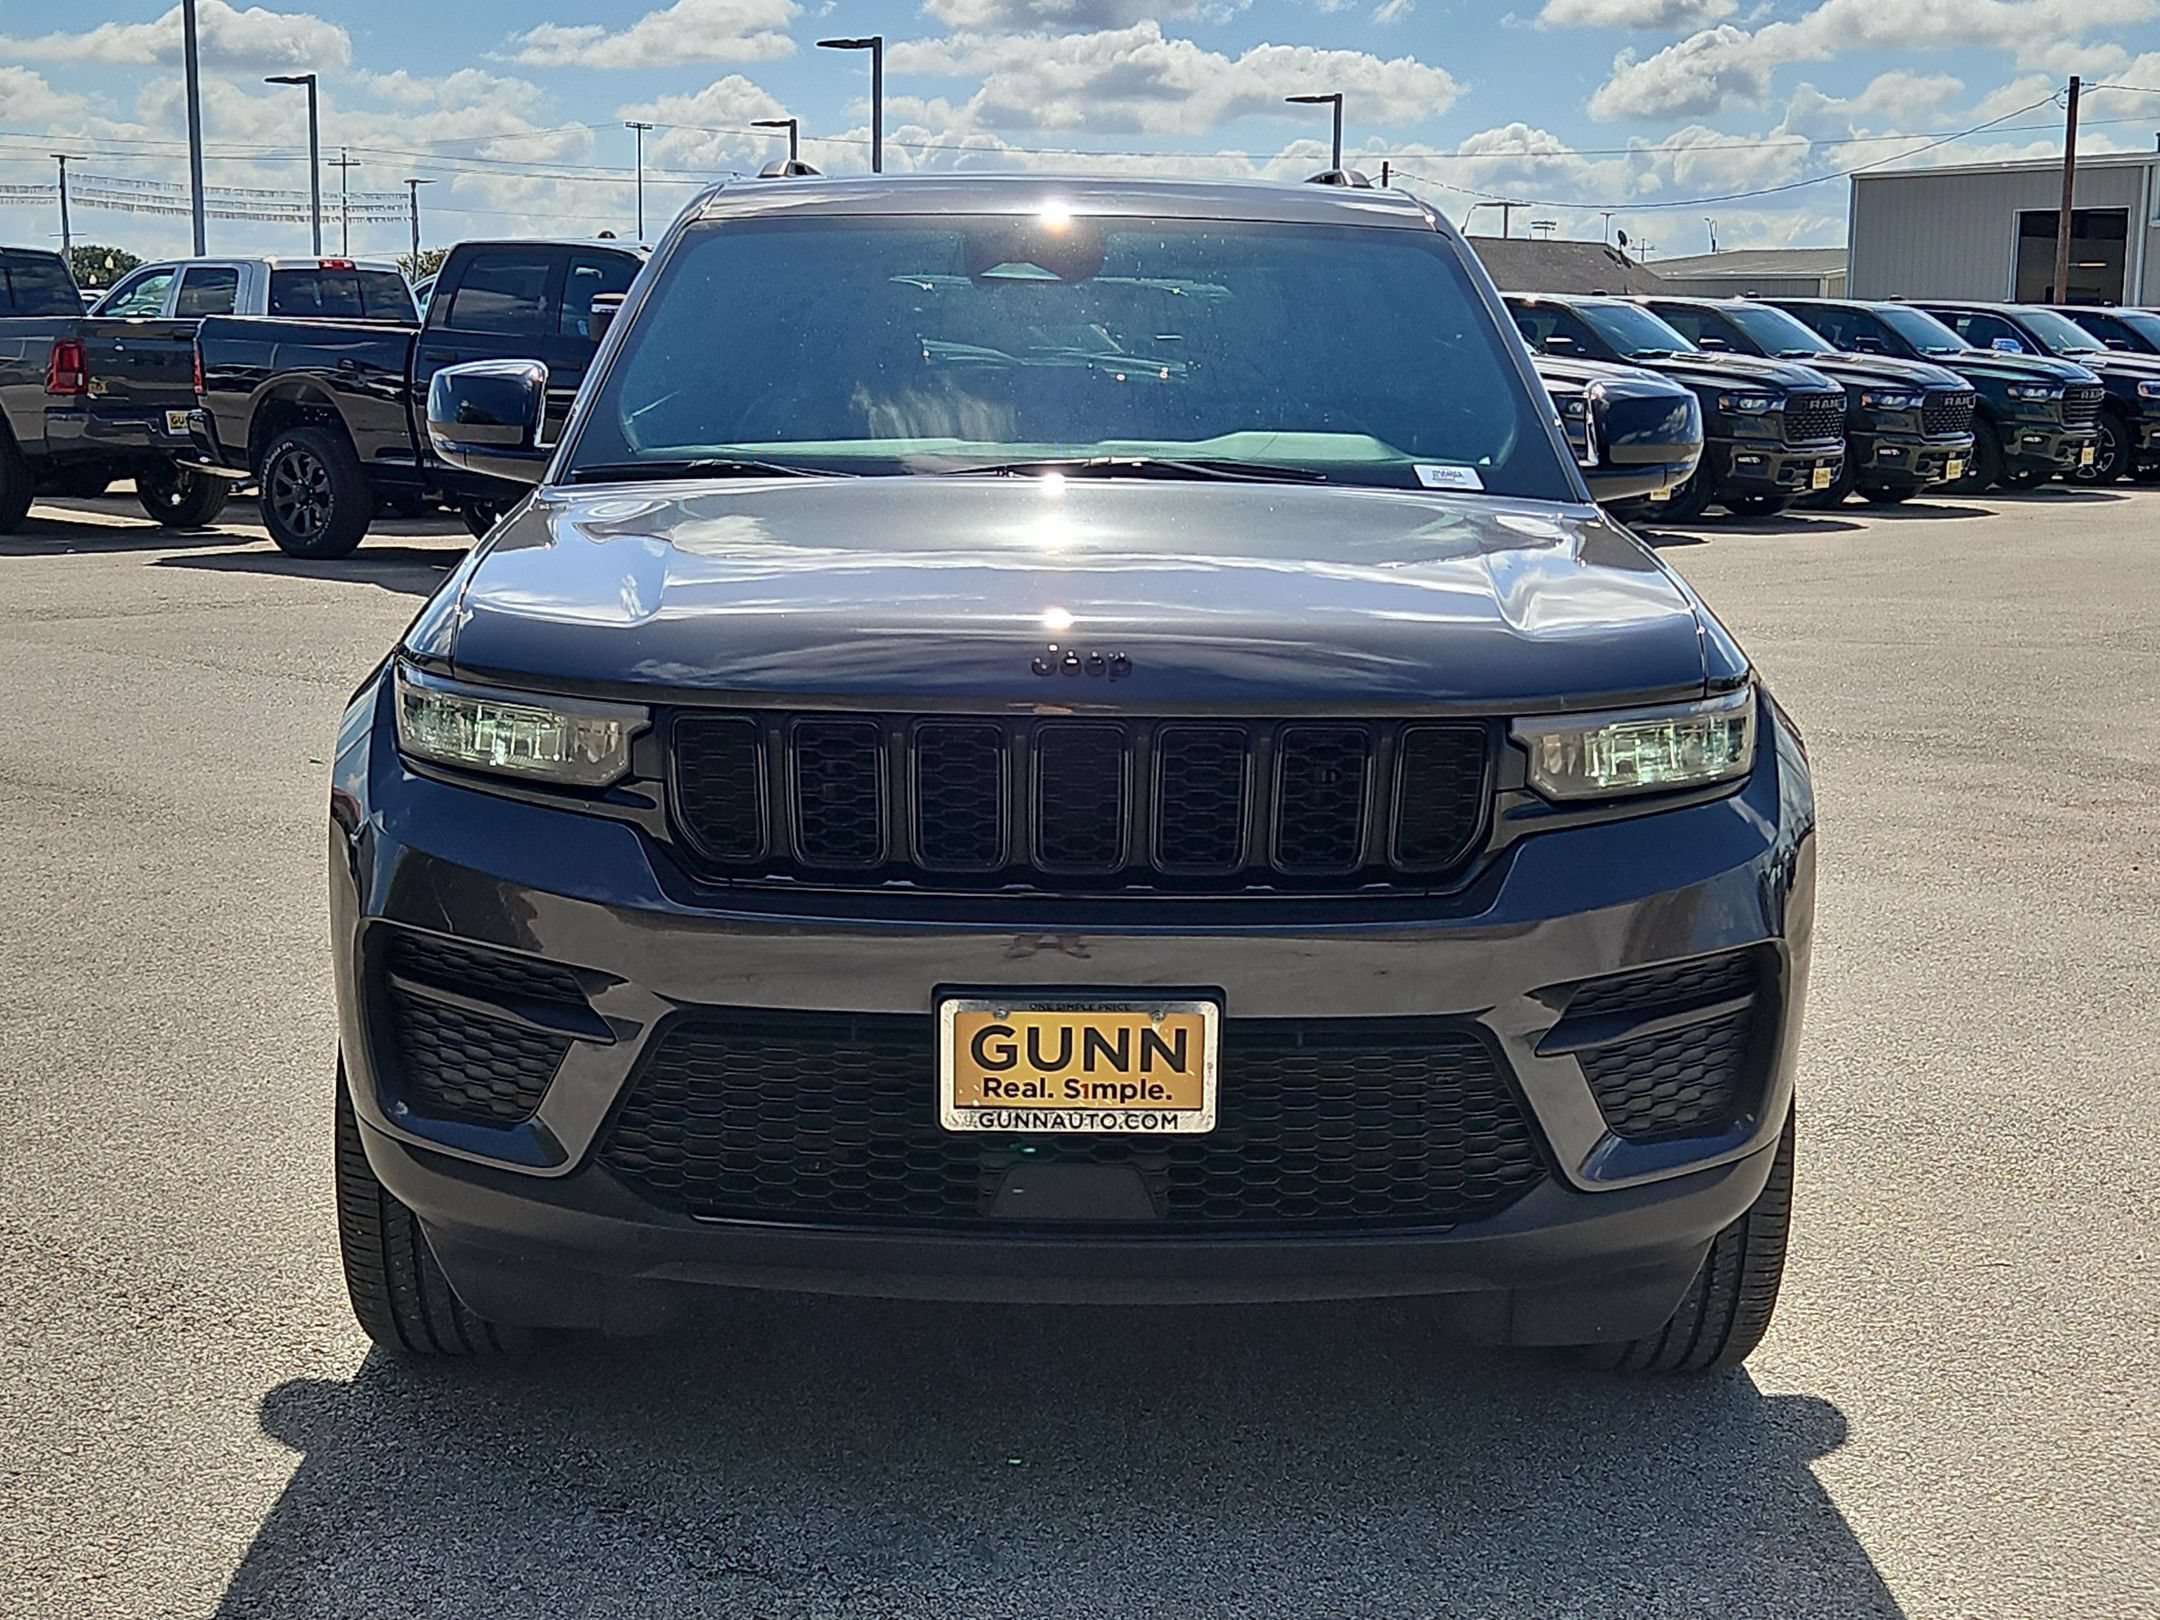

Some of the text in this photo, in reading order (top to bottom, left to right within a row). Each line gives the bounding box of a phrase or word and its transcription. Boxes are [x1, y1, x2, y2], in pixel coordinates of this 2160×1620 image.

[1031, 643, 1132, 682] Jeep
[1029, 1003, 1130, 1012] ONE SIMPLE PRICE
[970, 1025, 1188, 1074] GUNN
[982, 1077, 1054, 1099] Real.
[978, 1111, 1179, 1131] GUNNAUTO.COM
